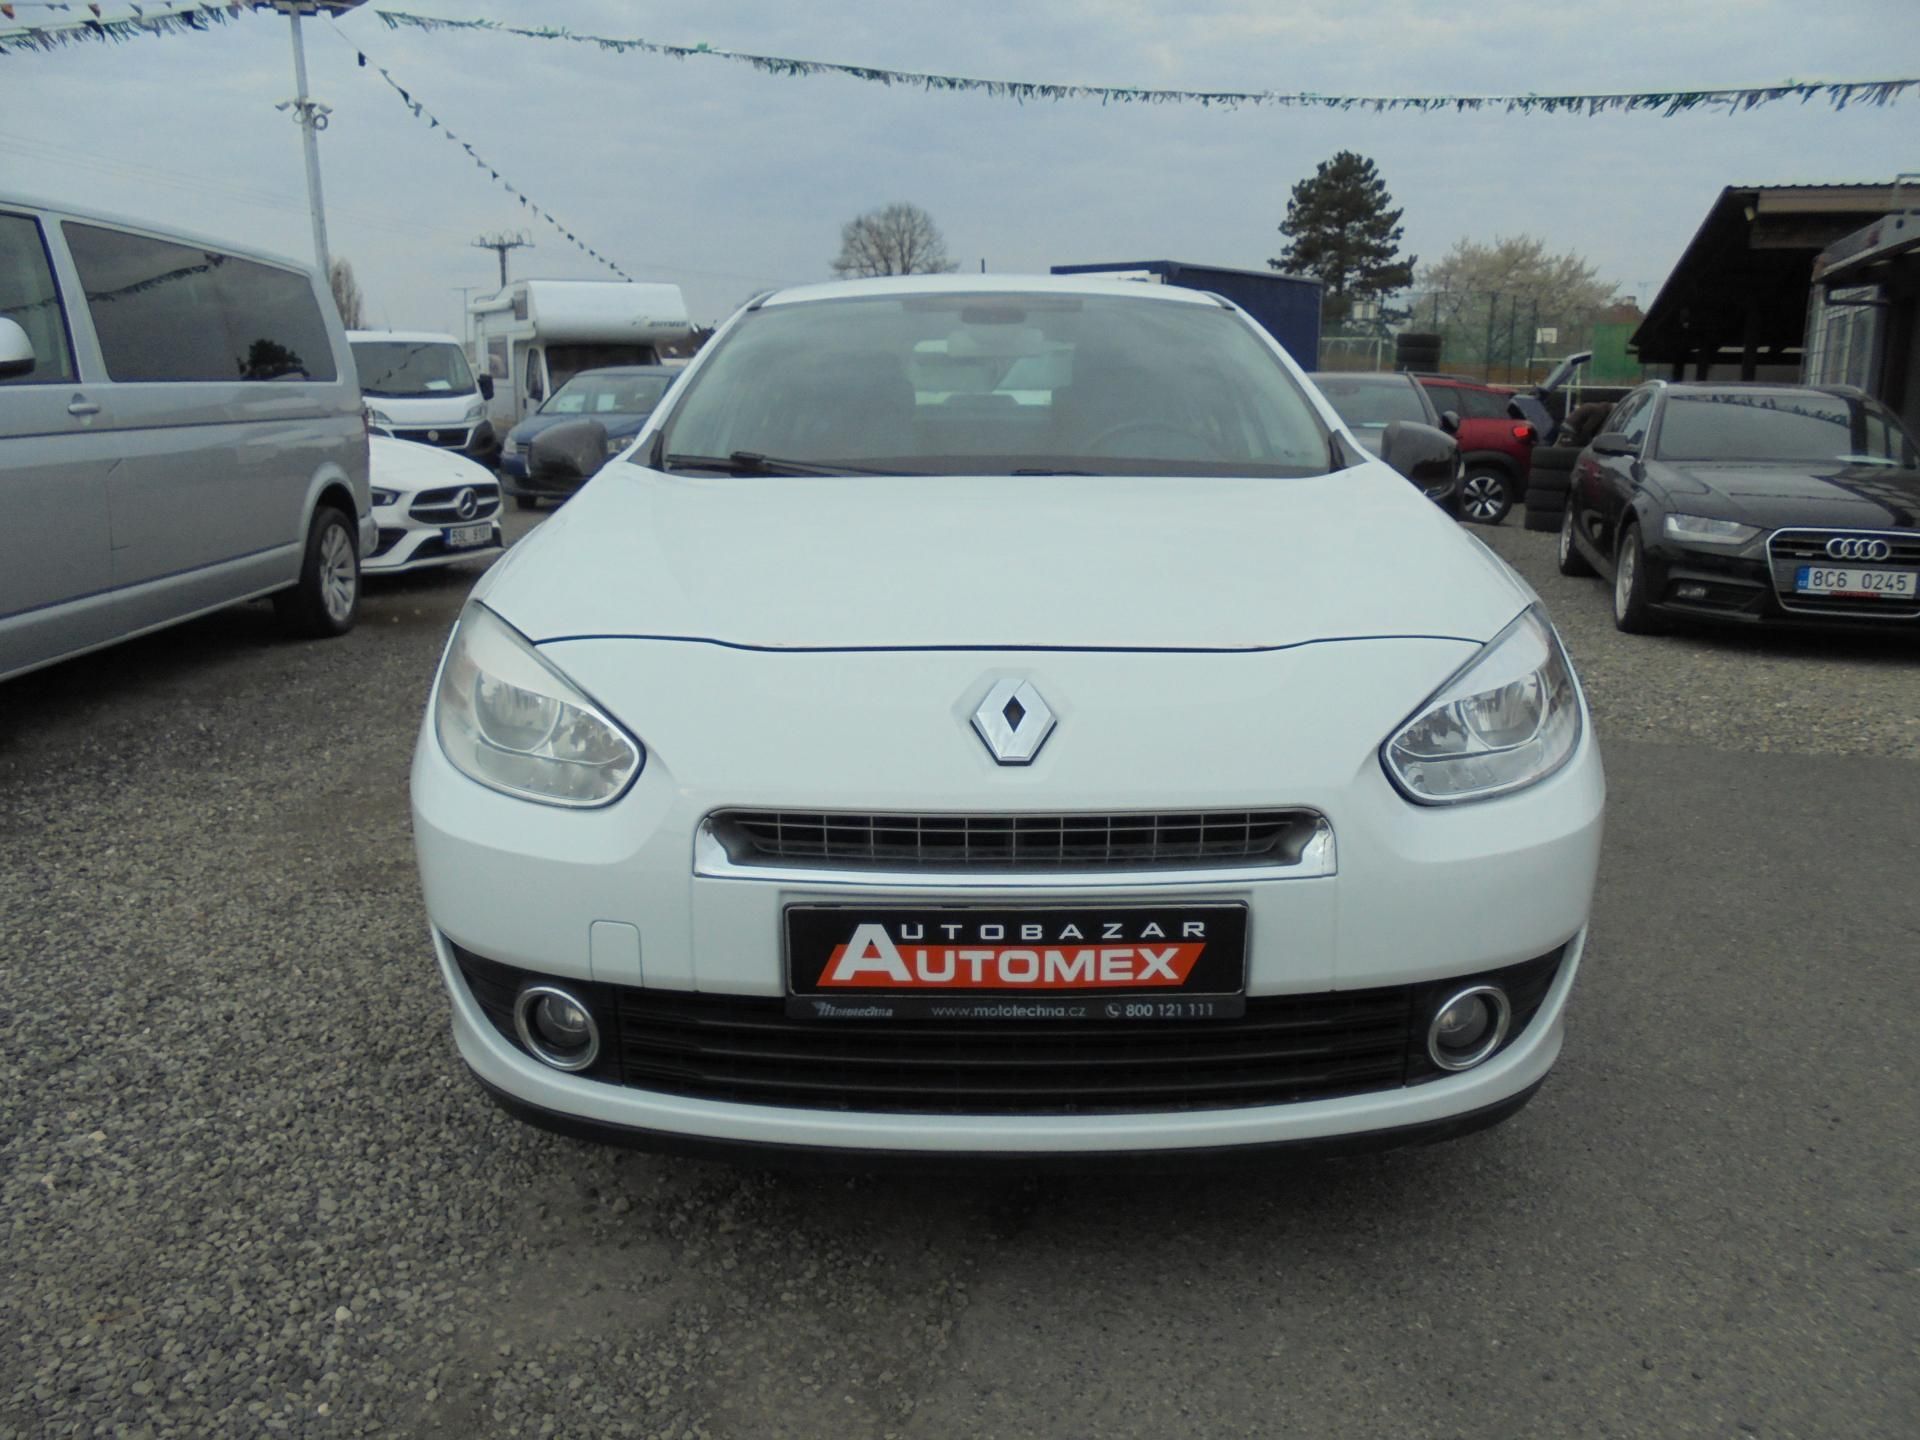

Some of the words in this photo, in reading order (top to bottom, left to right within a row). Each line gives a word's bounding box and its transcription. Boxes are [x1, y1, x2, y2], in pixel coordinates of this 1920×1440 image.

[1813, 570, 1847, 588] 8C6
[1861, 573, 1907, 591] 0245
[832, 923, 1180, 982] AUTOMEX
[931, 1004, 1087, 1018] www.mototechna.cz
[1125, 1004, 1153, 1017] 800
[1158, 1004, 1182, 1017] 121
[1189, 1003, 1214, 1017] 111
